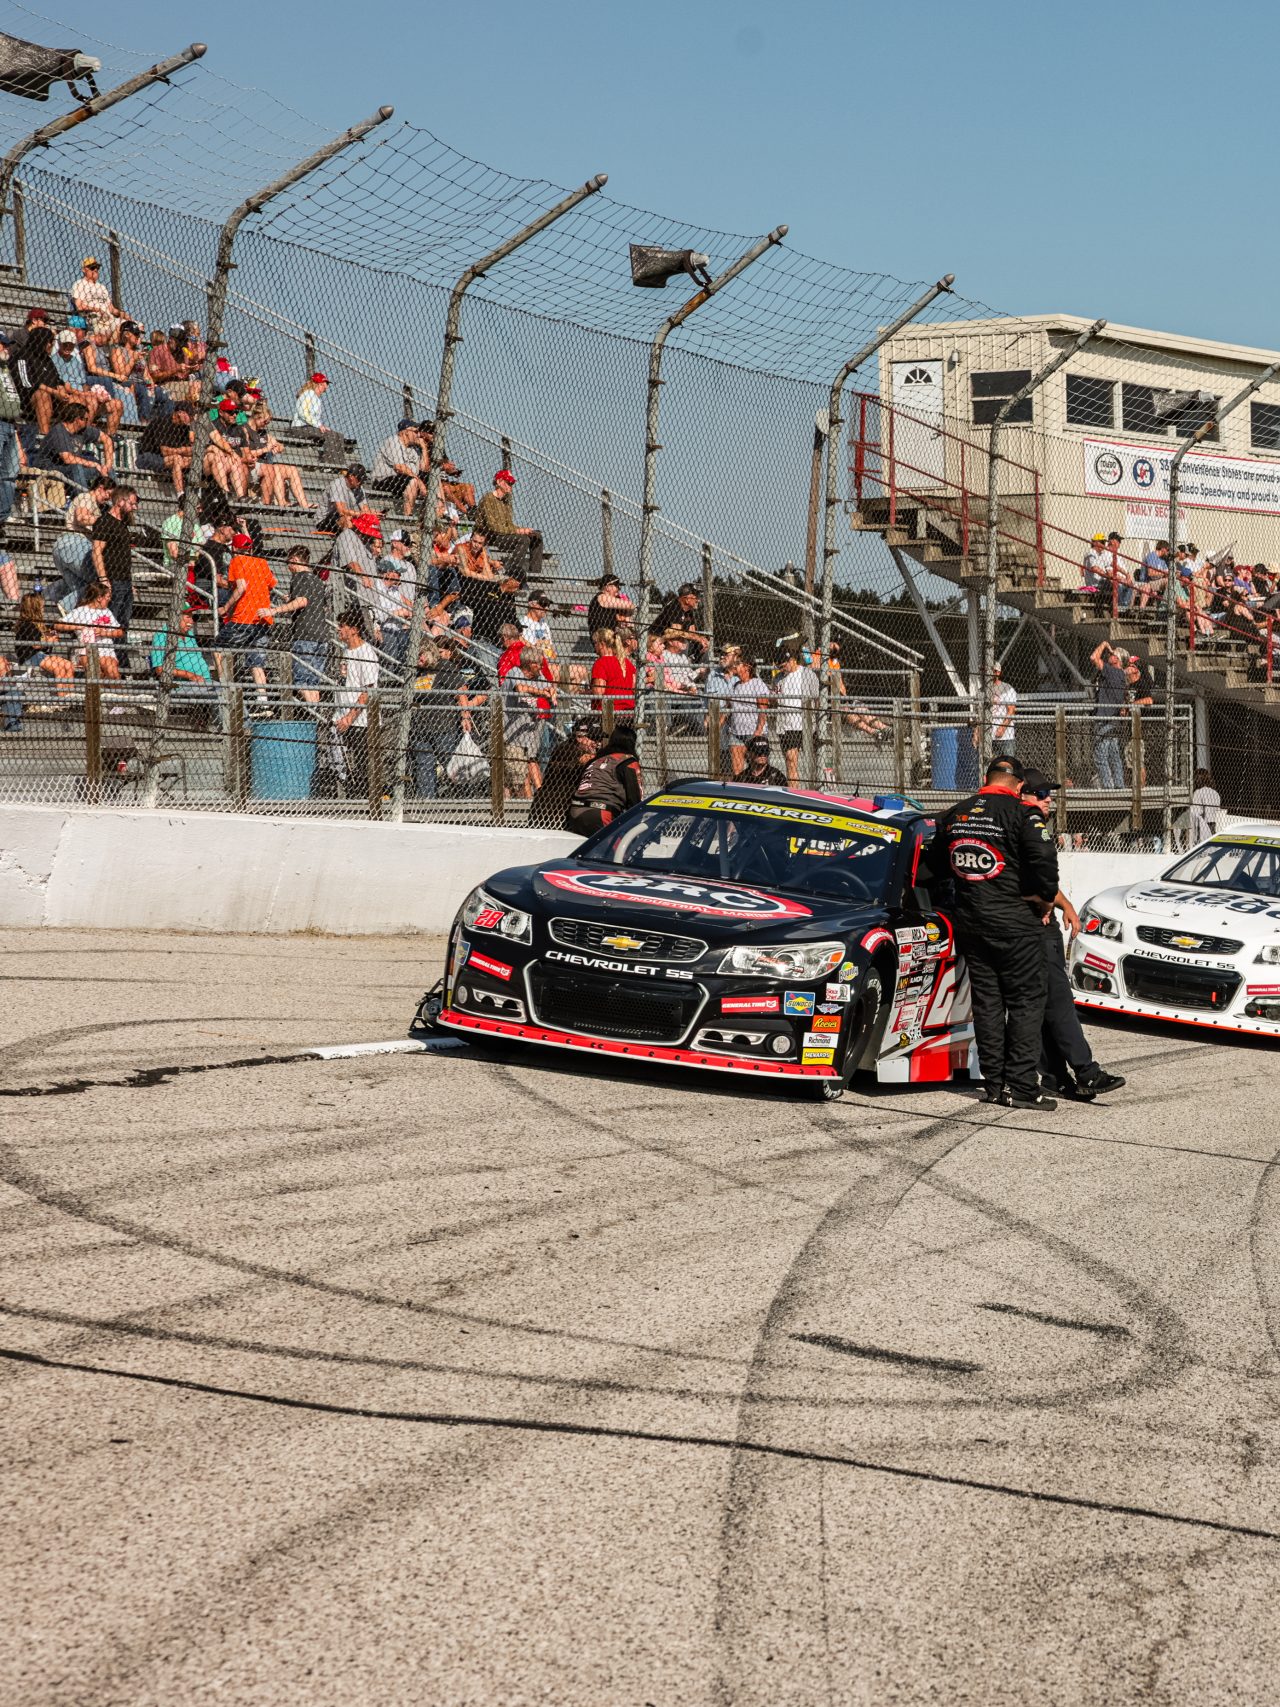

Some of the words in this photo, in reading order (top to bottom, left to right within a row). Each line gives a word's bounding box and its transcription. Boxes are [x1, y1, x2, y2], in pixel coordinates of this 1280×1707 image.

[1221, 466, 1240, 479] Stores
[1243, 471, 1255, 481] are
[1255, 471, 1275, 485] proud
[1178, 482, 1198, 495] oledo
[1200, 484, 1235, 502] Speedway
[1236, 489, 1250, 500] and
[1251, 490, 1270, 504] proud
[1271, 491, 1278, 502] to
[1127, 504, 1152, 517] FAMILY
[1155, 507, 1185, 519] SECN
[711, 801, 834, 824] MENARDS
[954, 851, 992, 869] BRC
[590, 875, 766, 908] BRC
[627, 896, 712, 913] INDUSTRIAL
[1130, 896, 1218, 908] INCORPORATED
[474, 908, 504, 928] 28
[545, 951, 661, 976] CHEVROLET
[665, 969, 694, 980] SS
[1133, 948, 1212, 967] CHEVROLET
[1216, 962, 1236, 970] SS
[838, 966, 860, 983] Bounty
[786, 1000, 813, 1008] SUNOCO
[808, 1036, 832, 1044] Richmond
